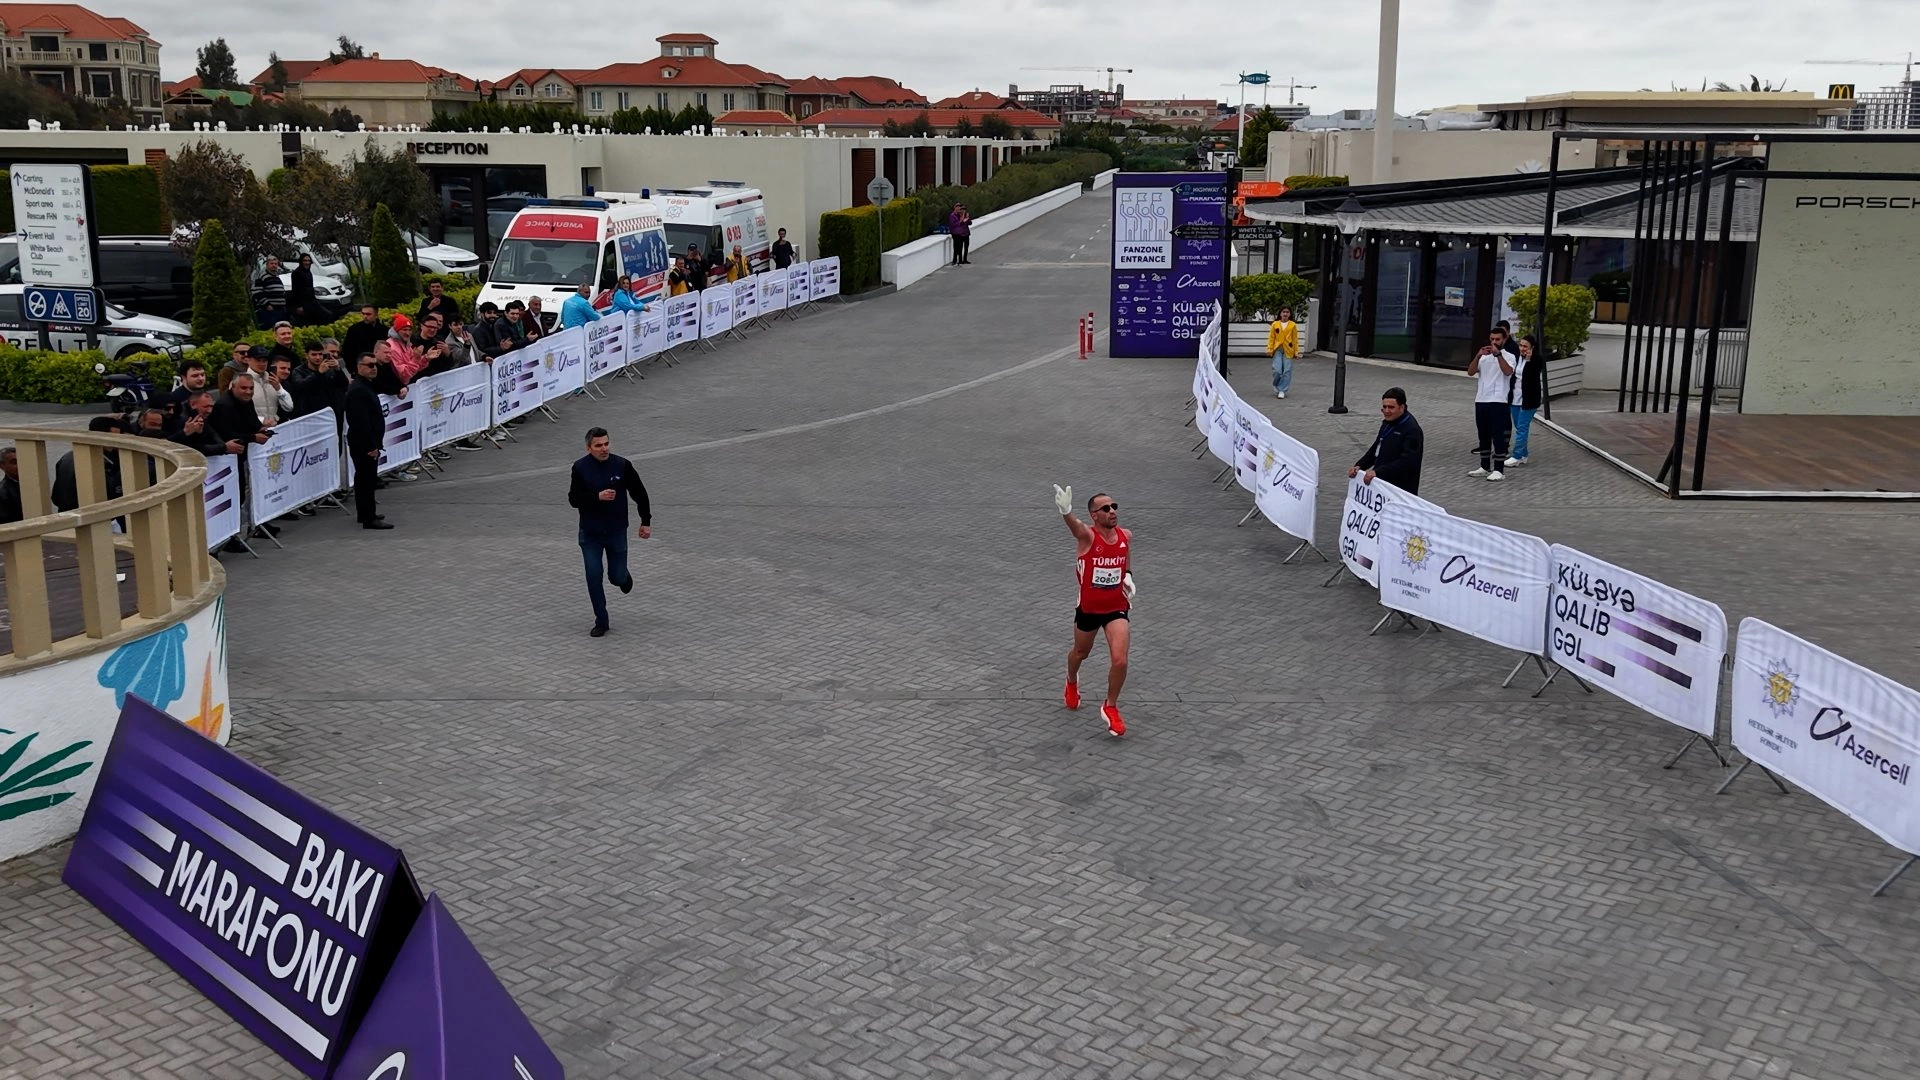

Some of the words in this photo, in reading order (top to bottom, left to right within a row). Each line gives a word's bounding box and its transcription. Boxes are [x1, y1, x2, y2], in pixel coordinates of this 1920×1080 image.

[406, 142, 489, 155] RECEPTION
[24, 187, 55, 195] McDonald's
[25, 200, 40, 208] Sport
[26, 212, 46, 220] Rescue
[28, 232, 43, 240] Event
[44, 232, 54, 240] Hall
[733, 225, 742, 240] 103
[46, 245, 63, 253] Beach
[30, 252, 43, 260] Club
[32, 268, 53, 278] Parking
[77, 307, 90, 317] 20
[1172, 300, 1215, 313] KÜLƏY
[1172, 314, 1208, 327] QALİB
[1171, 329, 1197, 339] GƏL
[305, 447, 330, 467] Azercell
[1283, 477, 1305, 501] Azercell
[1346, 510, 1380, 540] QALİB
[1342, 536, 1358, 562] GƏL
[1095, 575, 1120, 583] 20807
[1466, 573, 1520, 602] Azercell
[1557, 562, 1636, 613] KÜLƏYƏ
[1554, 594, 1611, 636] QALİB
[1553, 627, 1586, 664] GƏL
[1842, 734, 1911, 786] Azercell
[291, 832, 384, 938] BAKI
[165, 840, 357, 1017] MARAFONU
